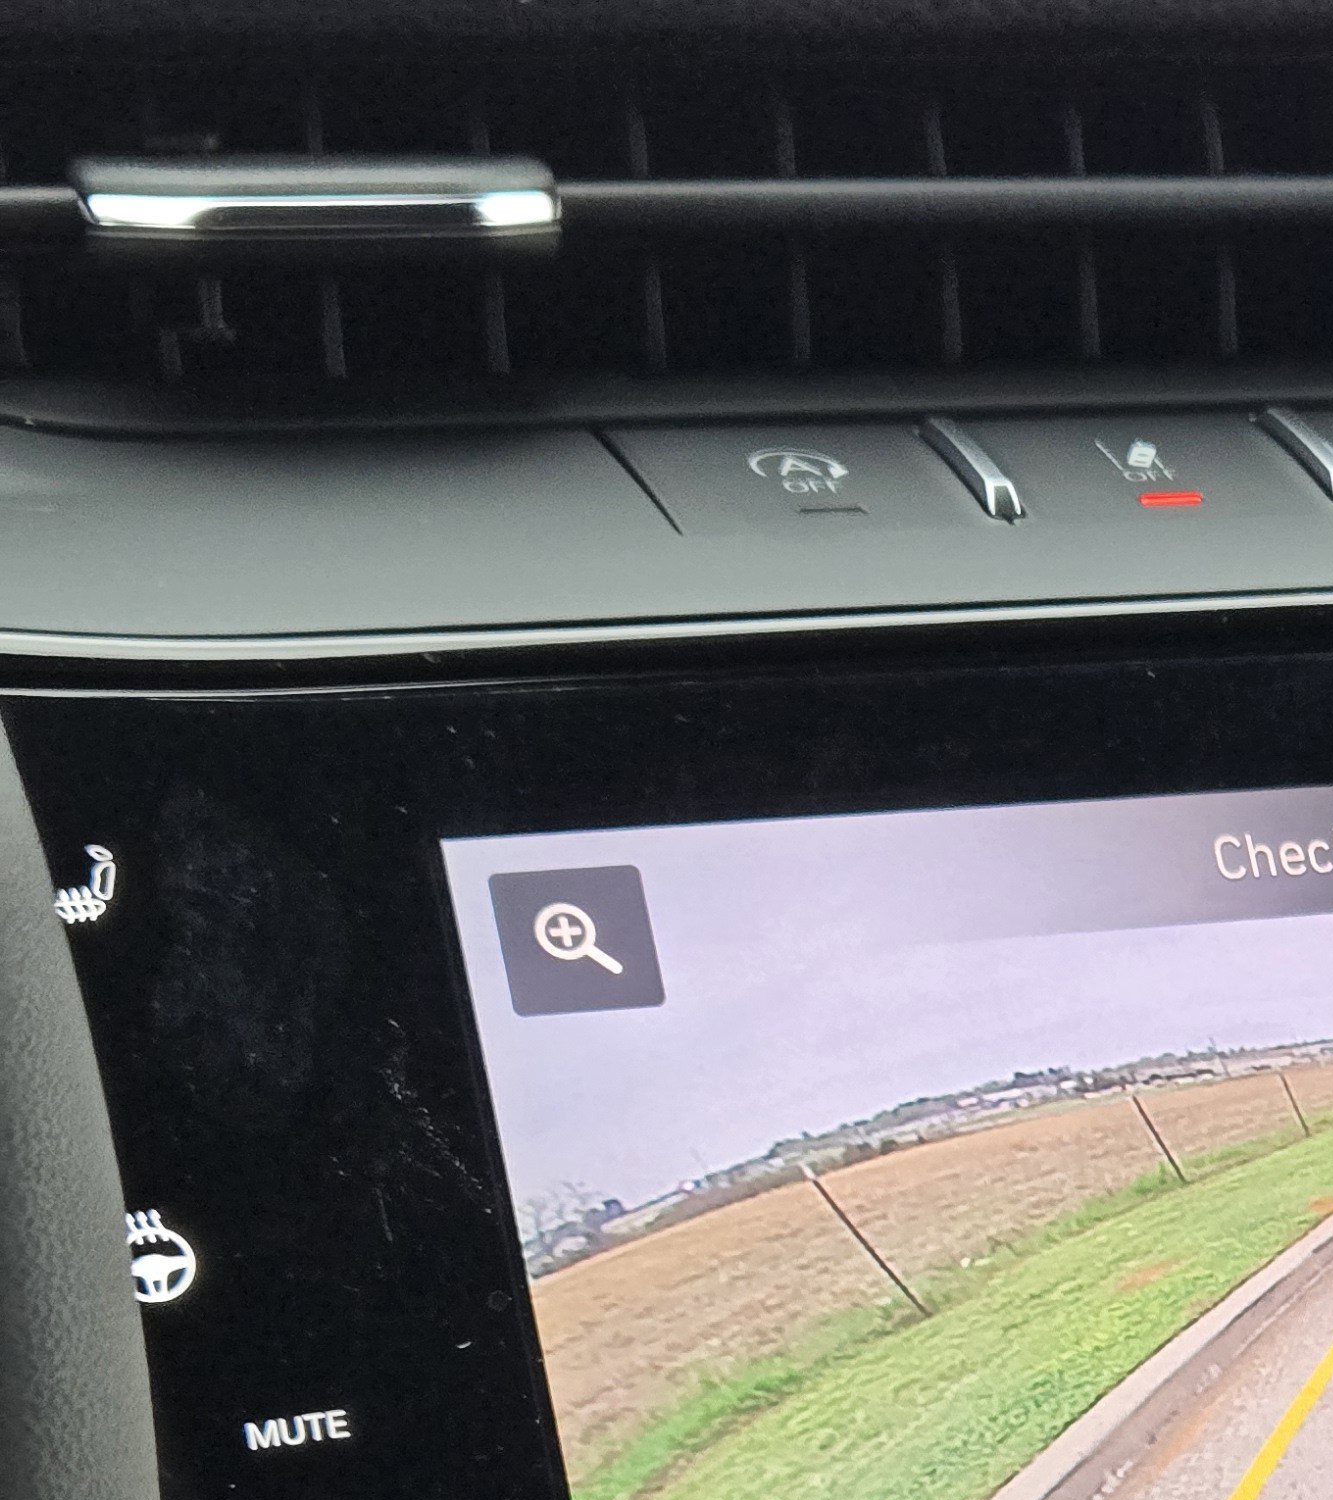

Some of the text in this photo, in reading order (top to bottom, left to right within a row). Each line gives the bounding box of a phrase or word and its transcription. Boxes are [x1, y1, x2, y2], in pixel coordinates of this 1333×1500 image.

[1122, 470, 1175, 482] OFF
[782, 477, 842, 494] OFF
[243, 1409, 351, 1450] MUTE
